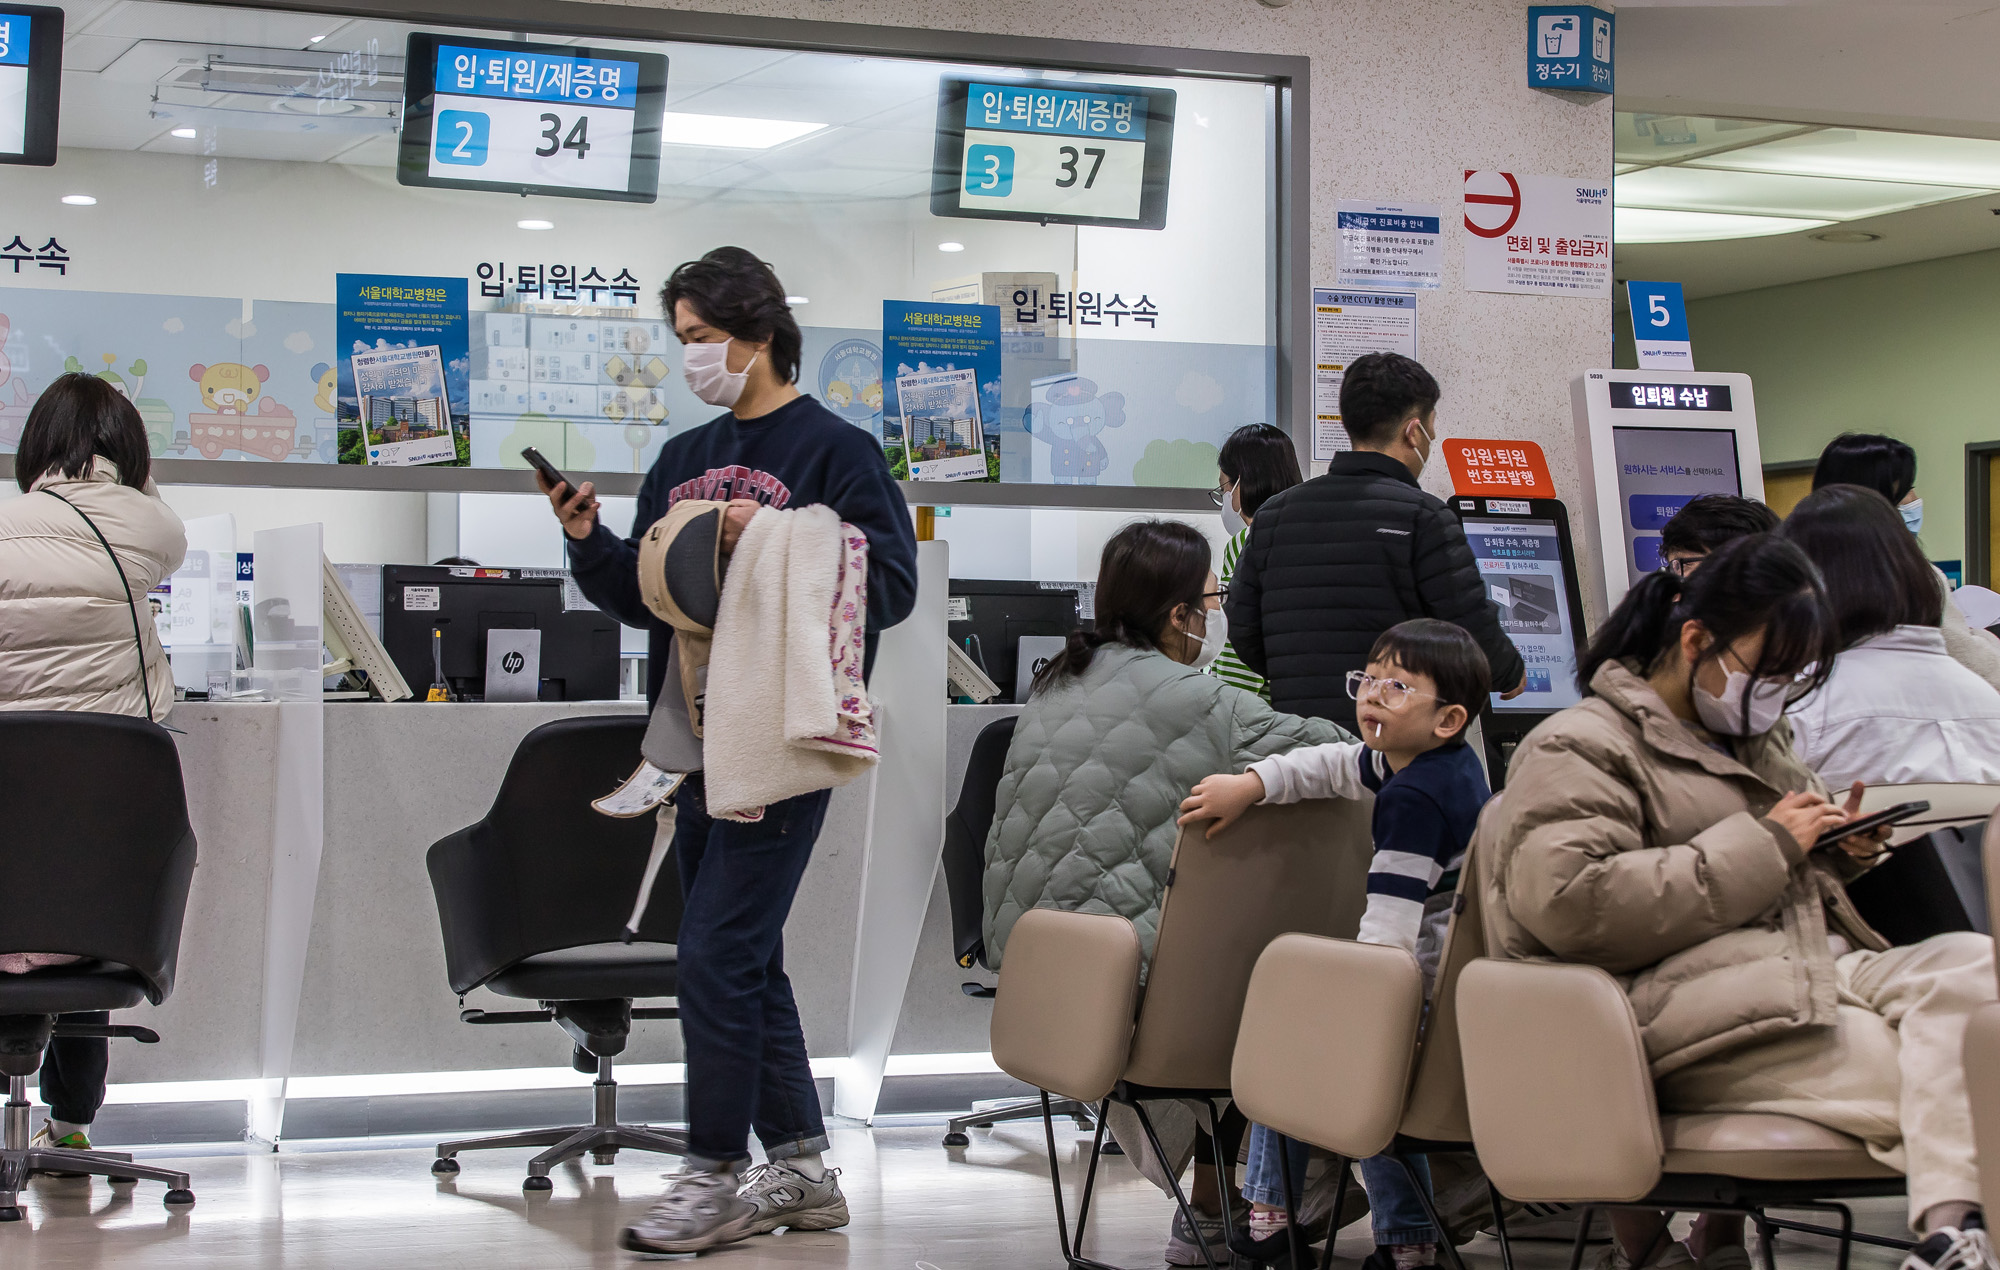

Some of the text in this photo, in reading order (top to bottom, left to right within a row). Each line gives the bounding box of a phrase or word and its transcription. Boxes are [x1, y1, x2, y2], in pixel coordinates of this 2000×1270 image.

[454, 54, 621, 100] 입·퇴원/제증명
[1536, 63, 1579, 80] 정수기
[1592, 65, 1610, 85] 정수기
[982, 92, 1132, 134] 입·퇴원/제증명
[452, 121, 473, 158] 2
[535, 112, 591, 159] 34
[980, 154, 1000, 189] 3
[1055, 145, 1106, 190] 37
[1576, 188, 1602, 198] SNUH
[1379, 218, 1407, 228] 진료비용
[1410, 220, 1424, 228] 안내
[1507, 235, 1608, 258] 면회 및 출입금지
[476, 262, 640, 304] 입·퇴원수속
[359, 286, 447, 302] 서울대학교병원은
[1012, 290, 1158, 328] 입·퇴원수속
[1648, 295, 1670, 327] 5
[903, 312, 982, 328] 서울대학교병원은
[835, 346, 878, 361] 서울대학교병원
[387, 367, 410, 377] 격려의
[362, 382, 386, 392] 감사히
[1632, 386, 1709, 408] 입퇴원 수납
[905, 402, 926, 412] 감사히
[1462, 448, 1528, 468] 입원·퇴원
[1467, 469, 1535, 486] 번호표발행
[1624, 464, 1725, 476] 원하시는 서비스를 선택하세요.
[1484, 538, 1540, 548] 입·퇴원 수속, 제증명
[1512, 562, 1541, 570] 읽혀주세요.
[504, 652, 522, 674] hp
[1534, 655, 1564, 663] 눌러주세요.
[768, 1187, 794, 1207] N
